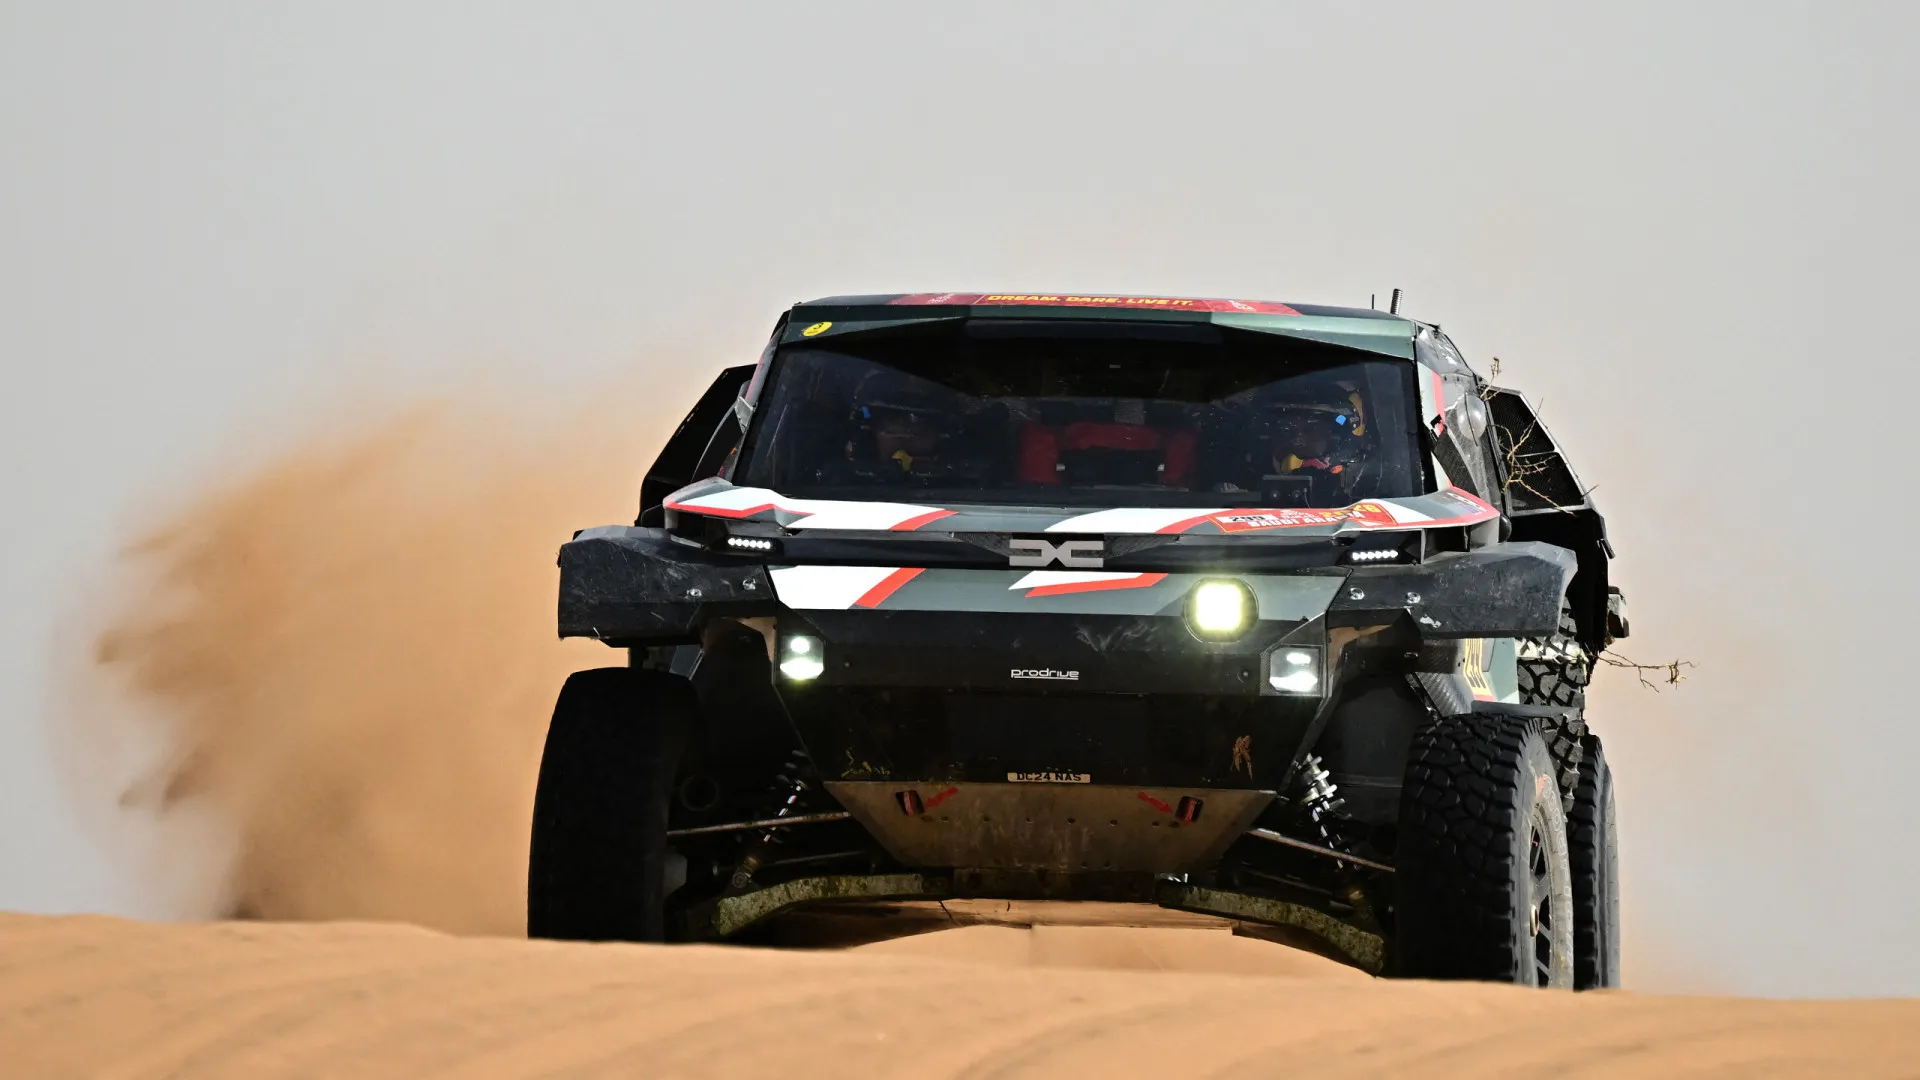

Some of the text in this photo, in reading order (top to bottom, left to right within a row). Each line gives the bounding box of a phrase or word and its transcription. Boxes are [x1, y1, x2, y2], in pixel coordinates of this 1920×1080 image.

[1248, 518, 1300, 528] SAUDI
[1011, 667, 1079, 680] prodrive
[1016, 772, 1082, 782] DC24 NAS
